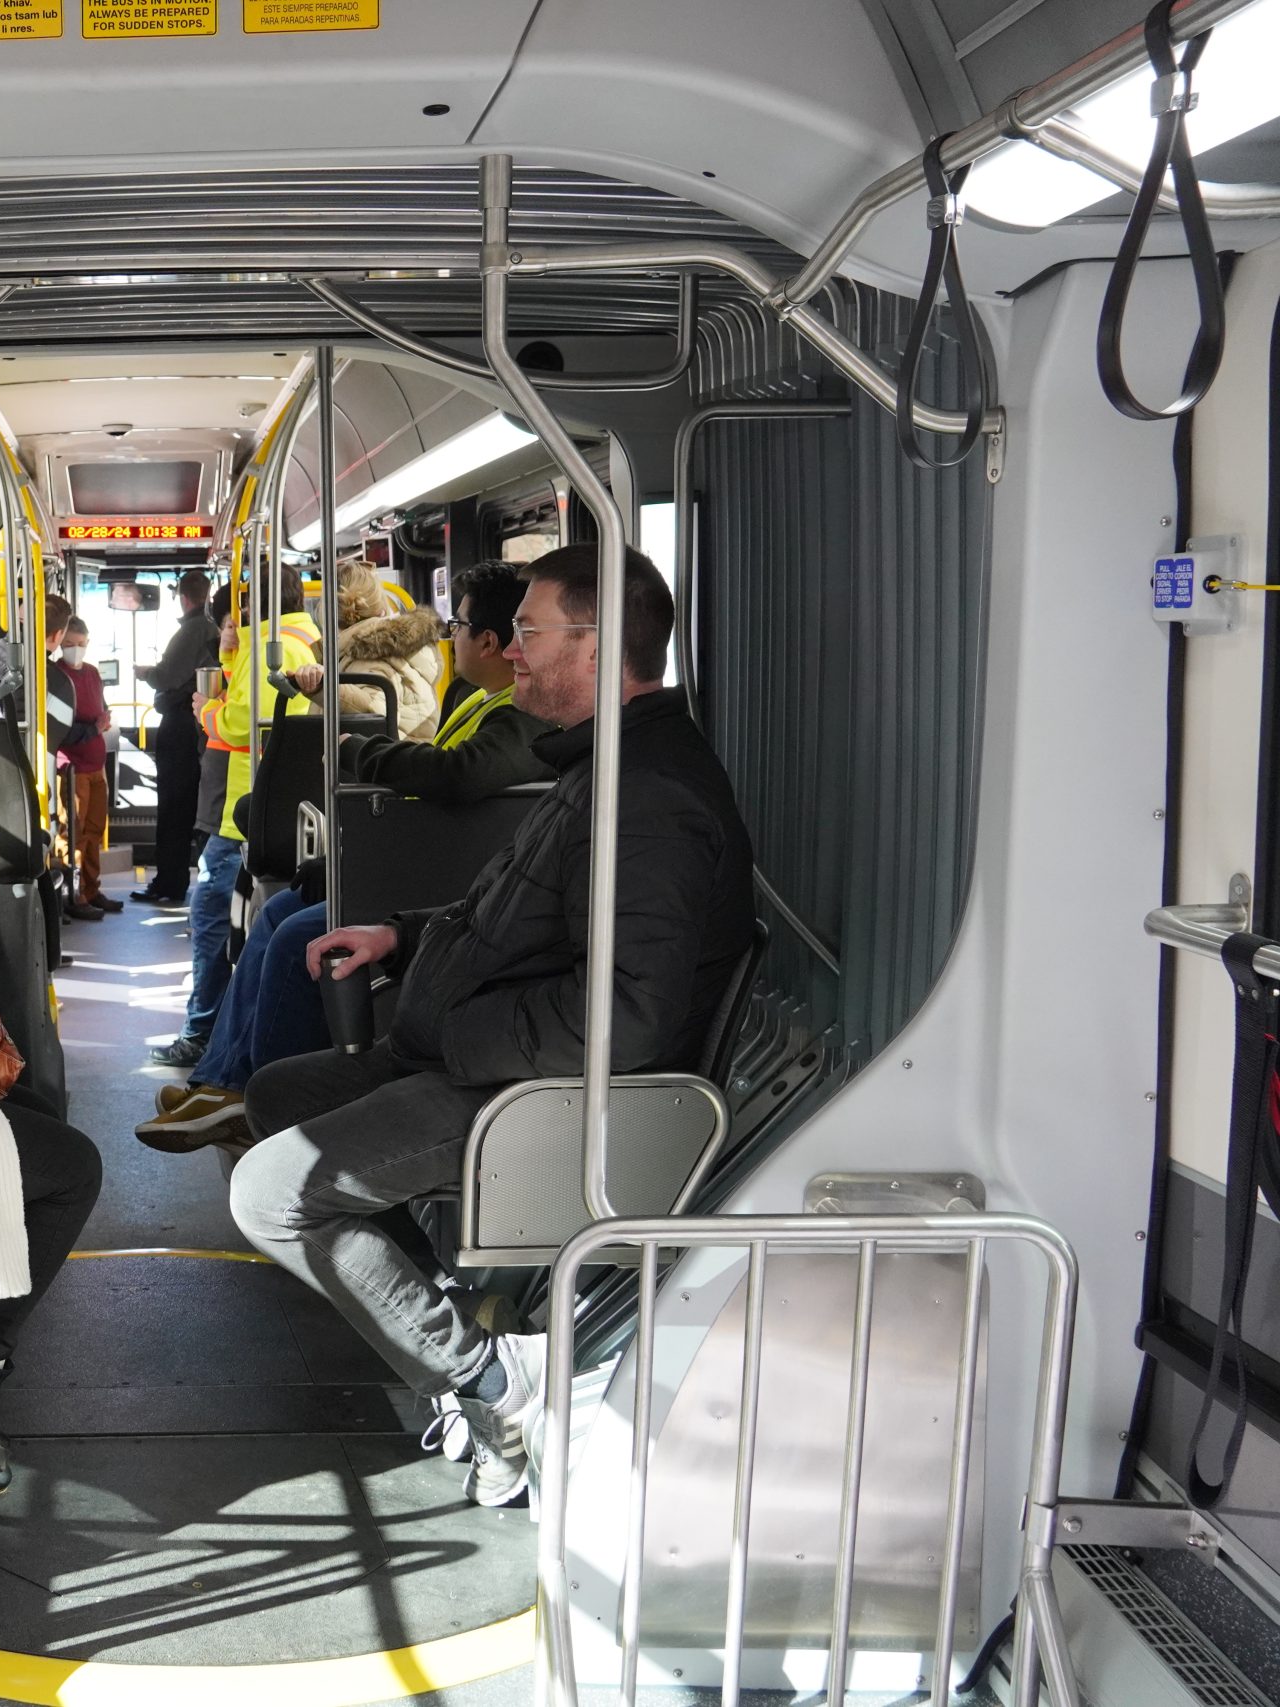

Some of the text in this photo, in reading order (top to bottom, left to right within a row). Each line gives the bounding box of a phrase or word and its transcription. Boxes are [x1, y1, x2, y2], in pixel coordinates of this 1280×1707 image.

[3, 0, 33, 8] khiav.
[263, 2, 359, 14] ESTE SIEMPRE PREPARADO
[15, 11, 40, 20] tsam
[42, 9, 58, 19] lub
[88, 7, 210, 19] ALWAYS BE PREPARED
[93, 19, 206, 31] FOR SUDDEN STOPS.
[260, 17, 279, 25] PARA
[280, 15, 314, 24] PARADAS
[1, 24, 8, 33] li
[10, 25, 35, 33] nres.
[68, 526, 201, 538] 02/28/24 10:32 AM
